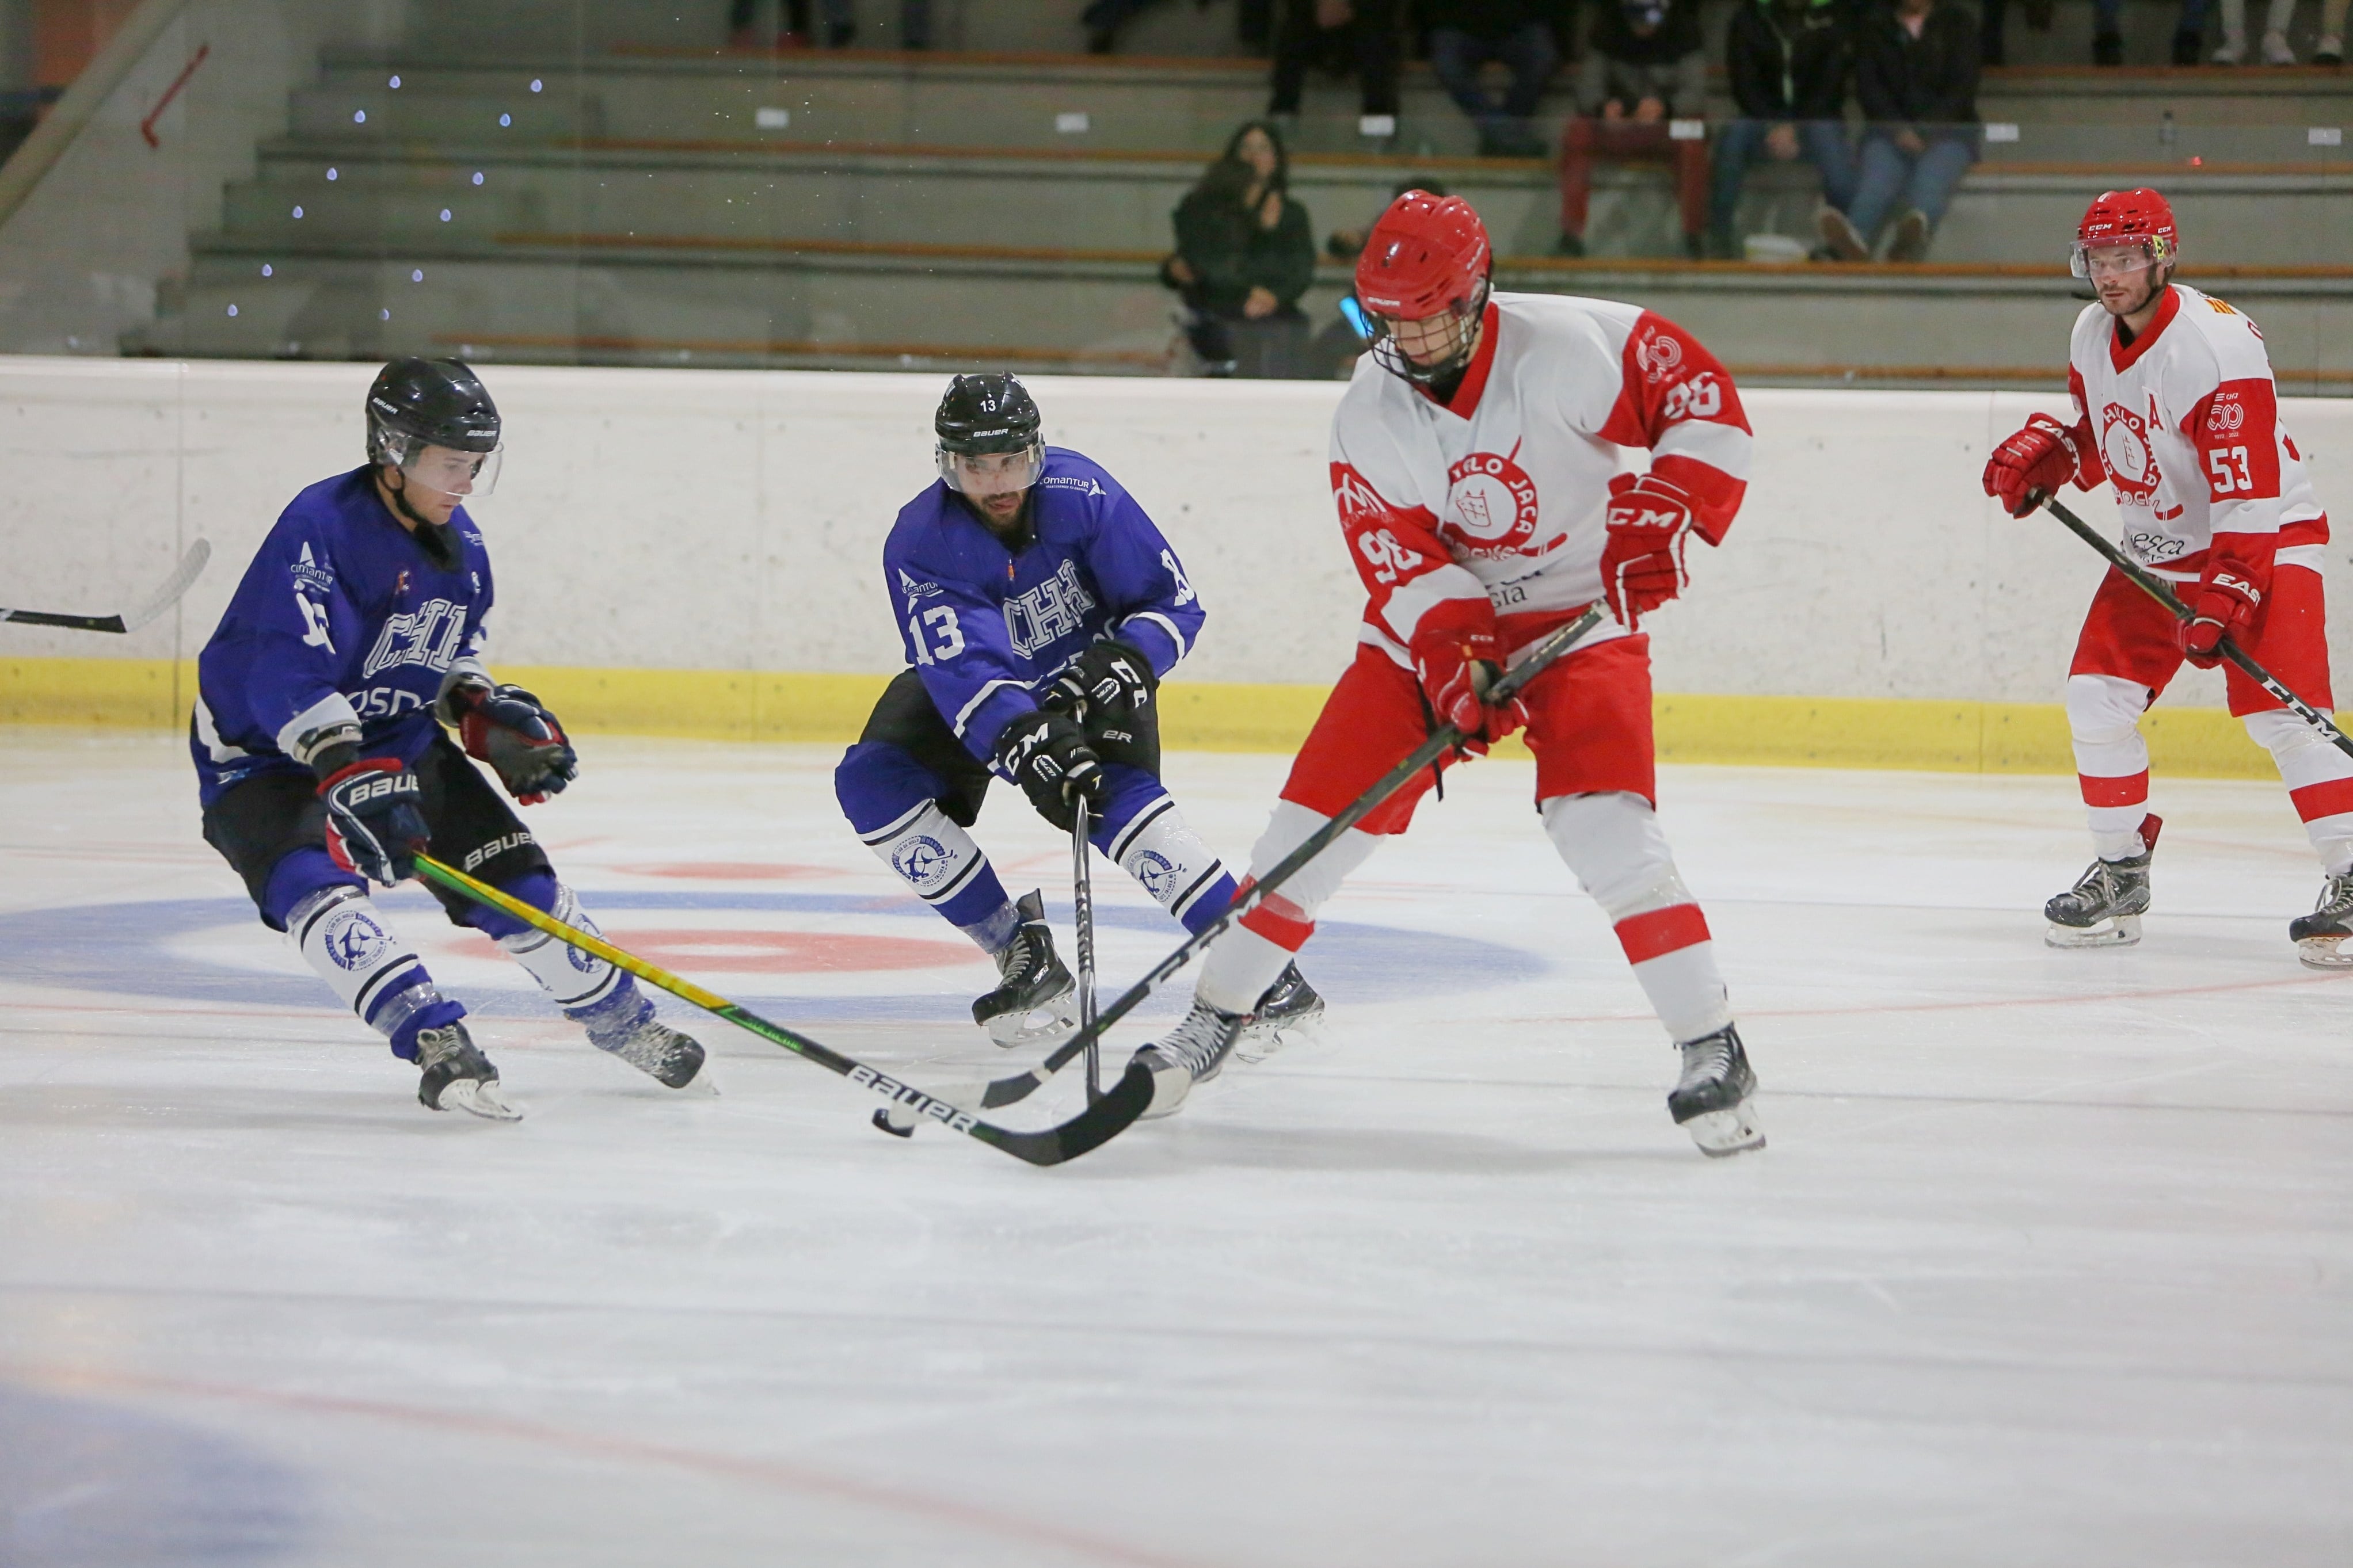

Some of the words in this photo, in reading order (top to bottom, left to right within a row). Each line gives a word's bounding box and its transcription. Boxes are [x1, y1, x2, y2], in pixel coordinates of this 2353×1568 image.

[2088, 223, 2112, 232] CCM
[980, 400, 996, 412] 13
[2149, 393, 2164, 431] A
[973, 428, 1008, 437] BAUER
[2209, 445, 2253, 493] 53
[1509, 478, 1536, 533] JACA
[1608, 508, 1677, 528] CM
[2130, 533, 2184, 555] esca
[909, 605, 965, 665] 13
[349, 775, 419, 806] BAUE
[846, 1065, 978, 1134] BAUER
